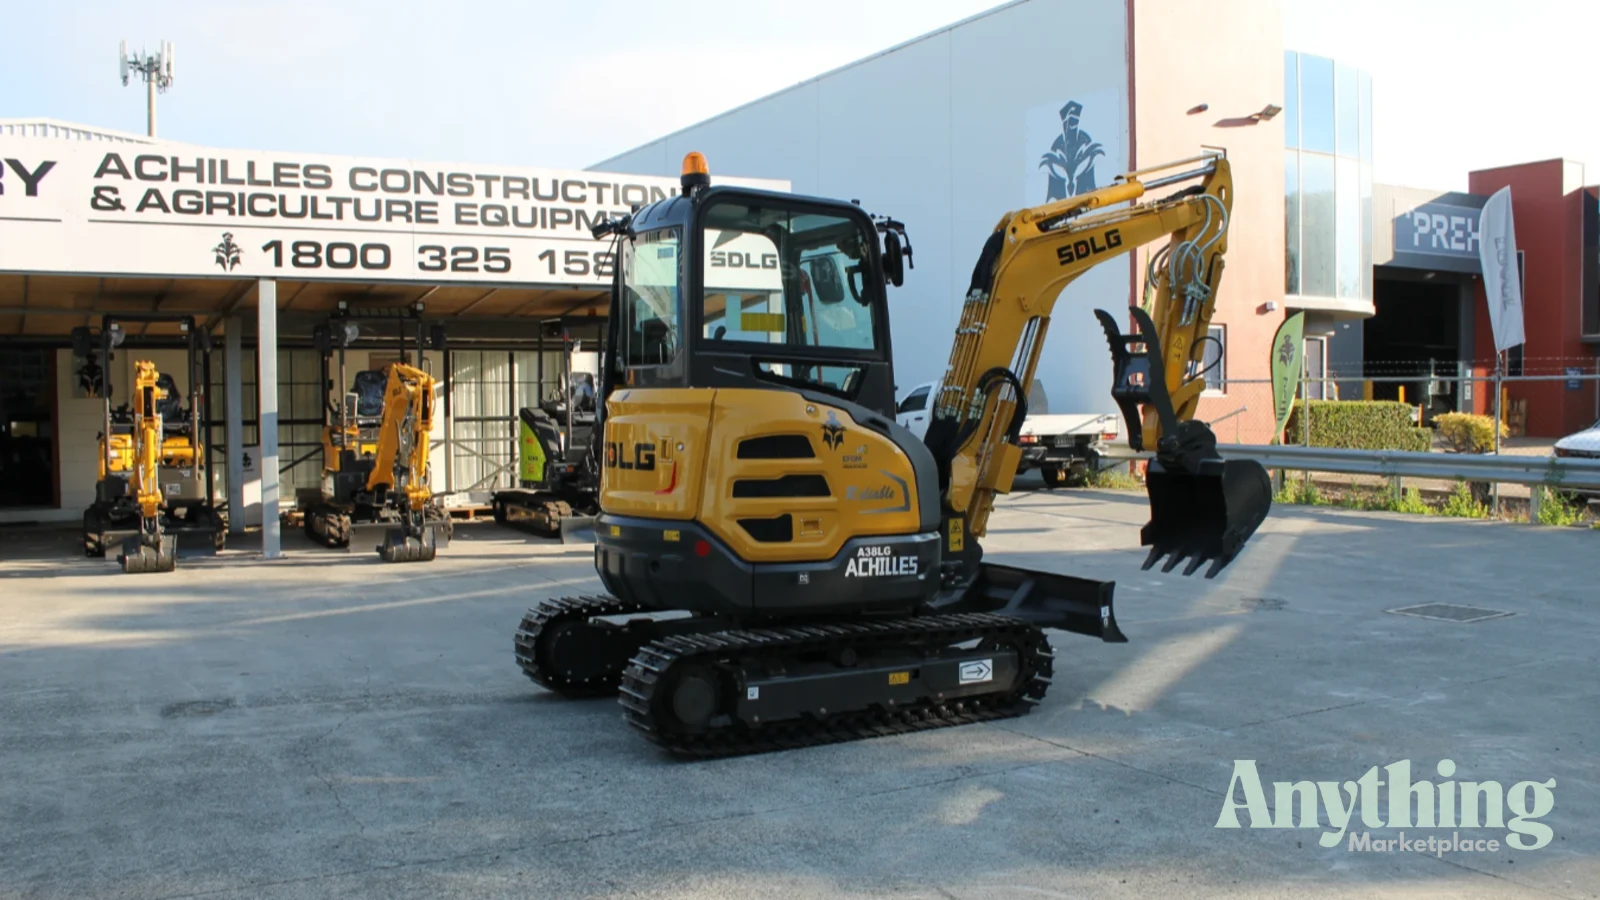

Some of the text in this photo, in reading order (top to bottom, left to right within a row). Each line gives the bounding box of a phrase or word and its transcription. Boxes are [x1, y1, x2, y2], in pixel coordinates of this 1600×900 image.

[0, 158, 57, 197] Y
[93, 152, 677, 207] ACHILLES CONSTRUCTION
[90, 185, 631, 231] & AGRICULTURE EQUIPM
[261, 240, 617, 277] 1800 325 158
[710, 251, 777, 269] SDLG
[1056, 228, 1122, 266] SDLG
[604, 442, 656, 471] DLG
[844, 555, 919, 577] ACHILLES
[857, 545, 892, 558] A38LG
